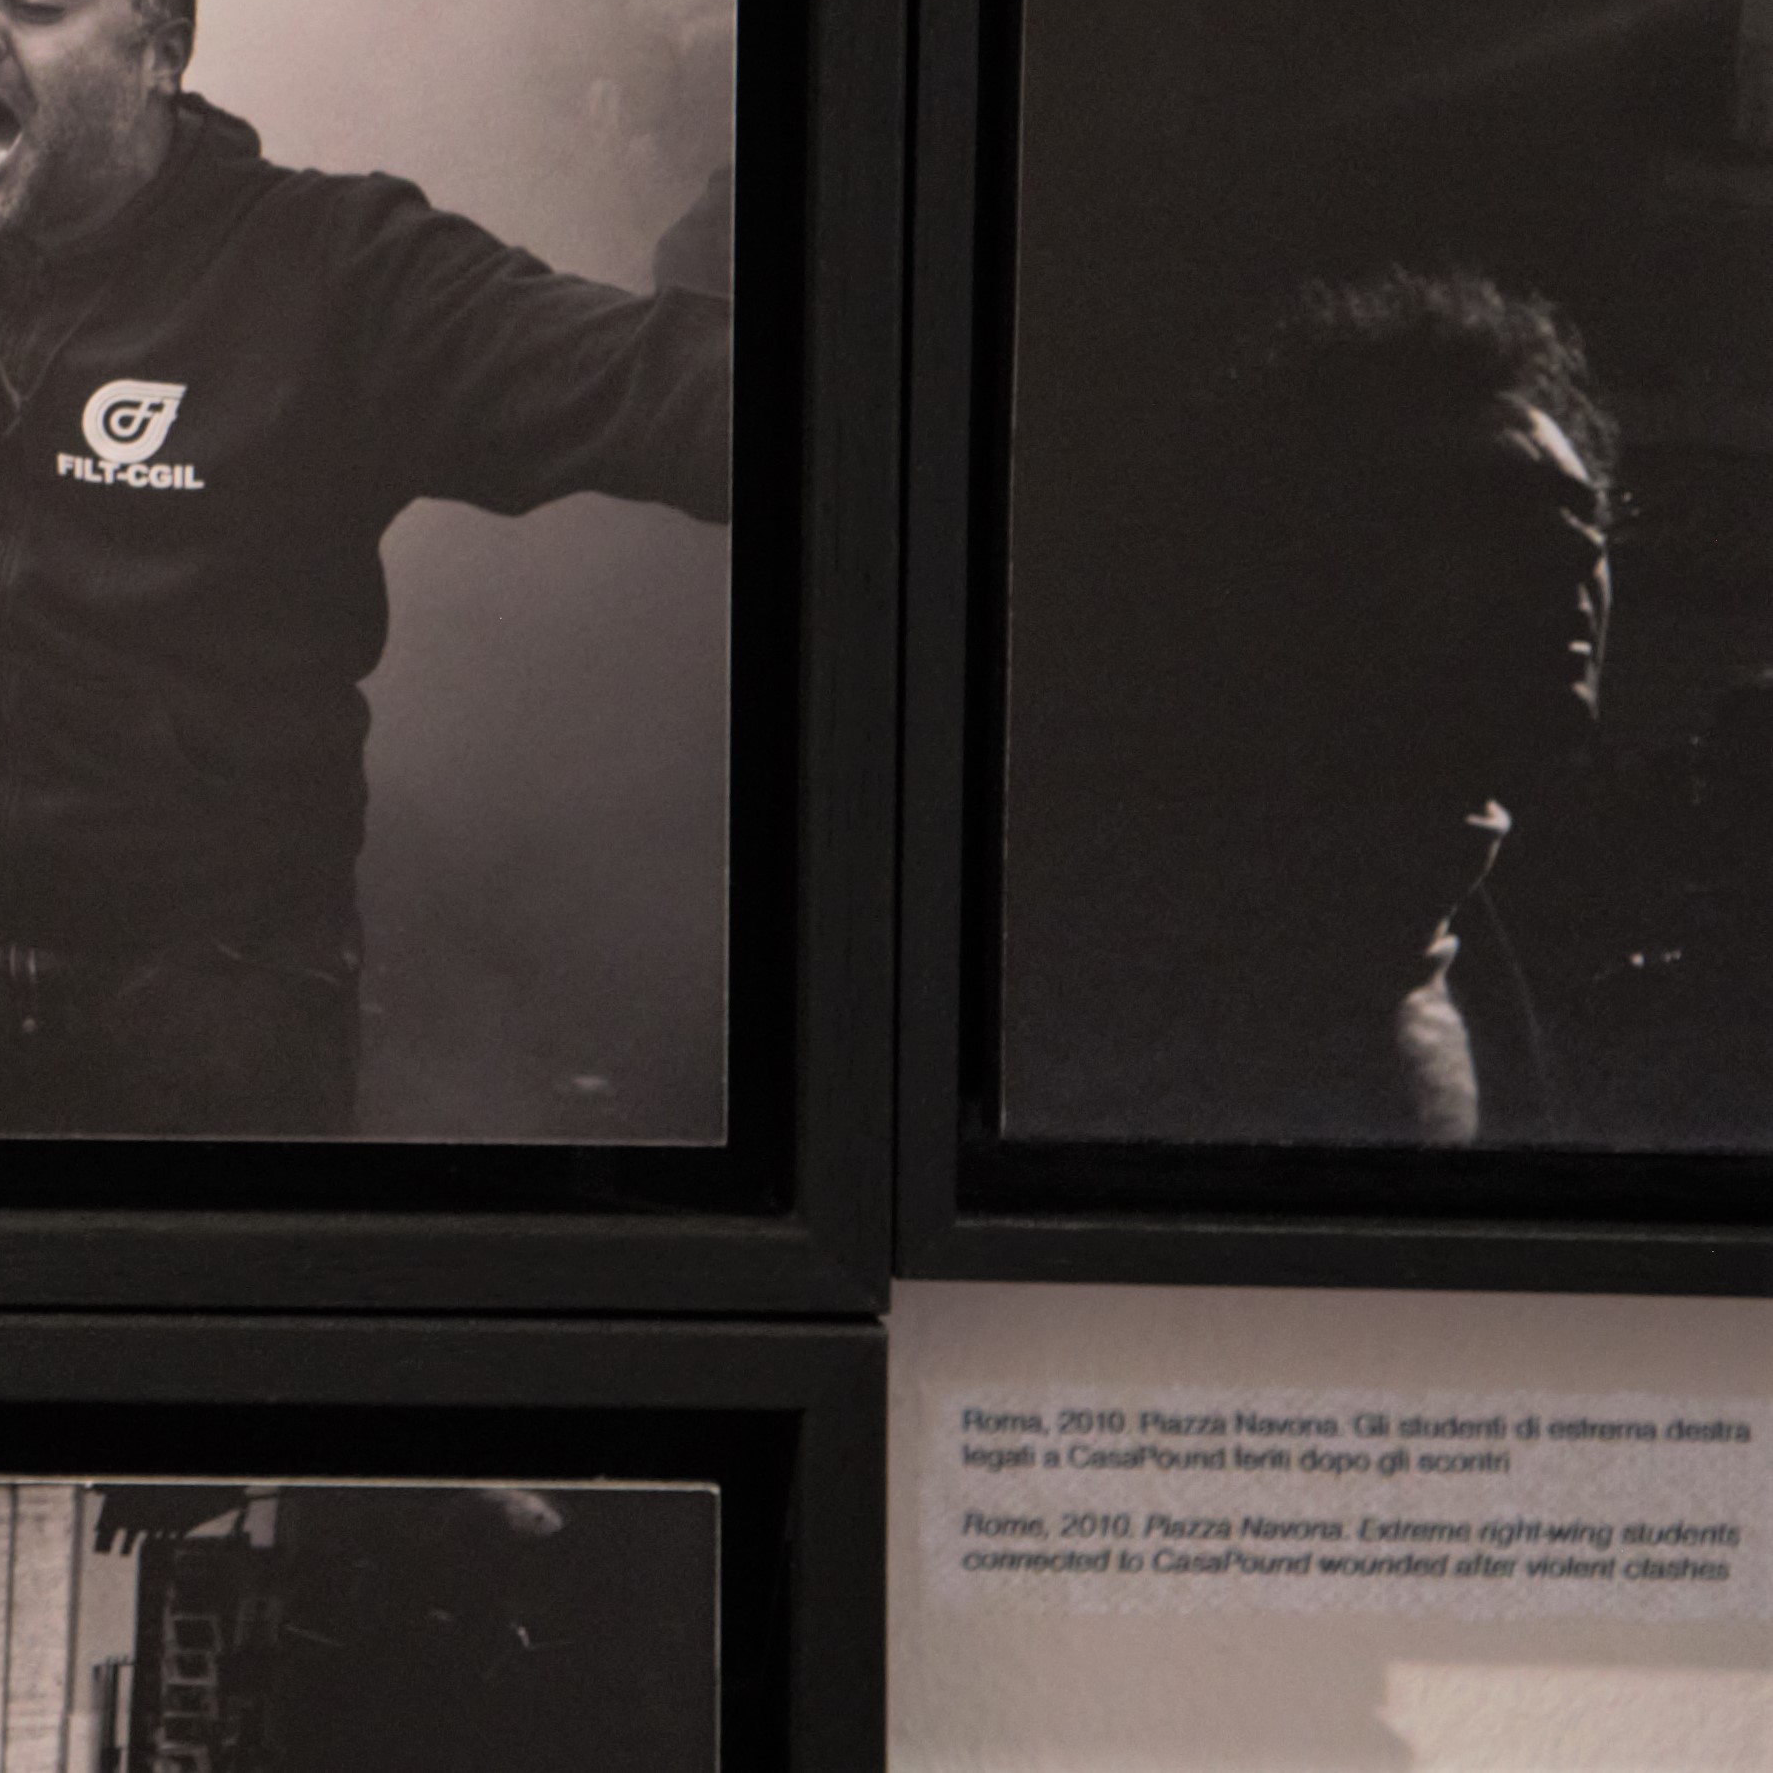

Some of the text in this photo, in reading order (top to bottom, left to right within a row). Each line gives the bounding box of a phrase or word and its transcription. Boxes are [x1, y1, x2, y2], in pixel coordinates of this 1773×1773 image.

[56, 452, 205, 491] FILT-CGIL
[960, 1408, 1049, 1437] Roma,
[1137, 1410, 1229, 1437] Piazza
[1351, 1410, 1391, 1439] Gli
[1397, 1414, 1508, 1442] studenti
[1513, 1414, 1542, 1441] di
[1547, 1416, 1659, 1443] estrema
[1664, 1417, 1753, 1444] destra
[960, 1443, 1512, 1478] legati a CasaPound feriti dopo gli scontri
[961, 1512, 1049, 1542] Rome,
[1142, 1513, 1234, 1541] Piazza
[1357, 1517, 1472, 1544] Extreme
[1476, 1520, 1615, 1550] right-wing
[1620, 1522, 1742, 1547] students
[960, 1548, 1731, 1581] connected to CasaPound wounded after violent clashes
